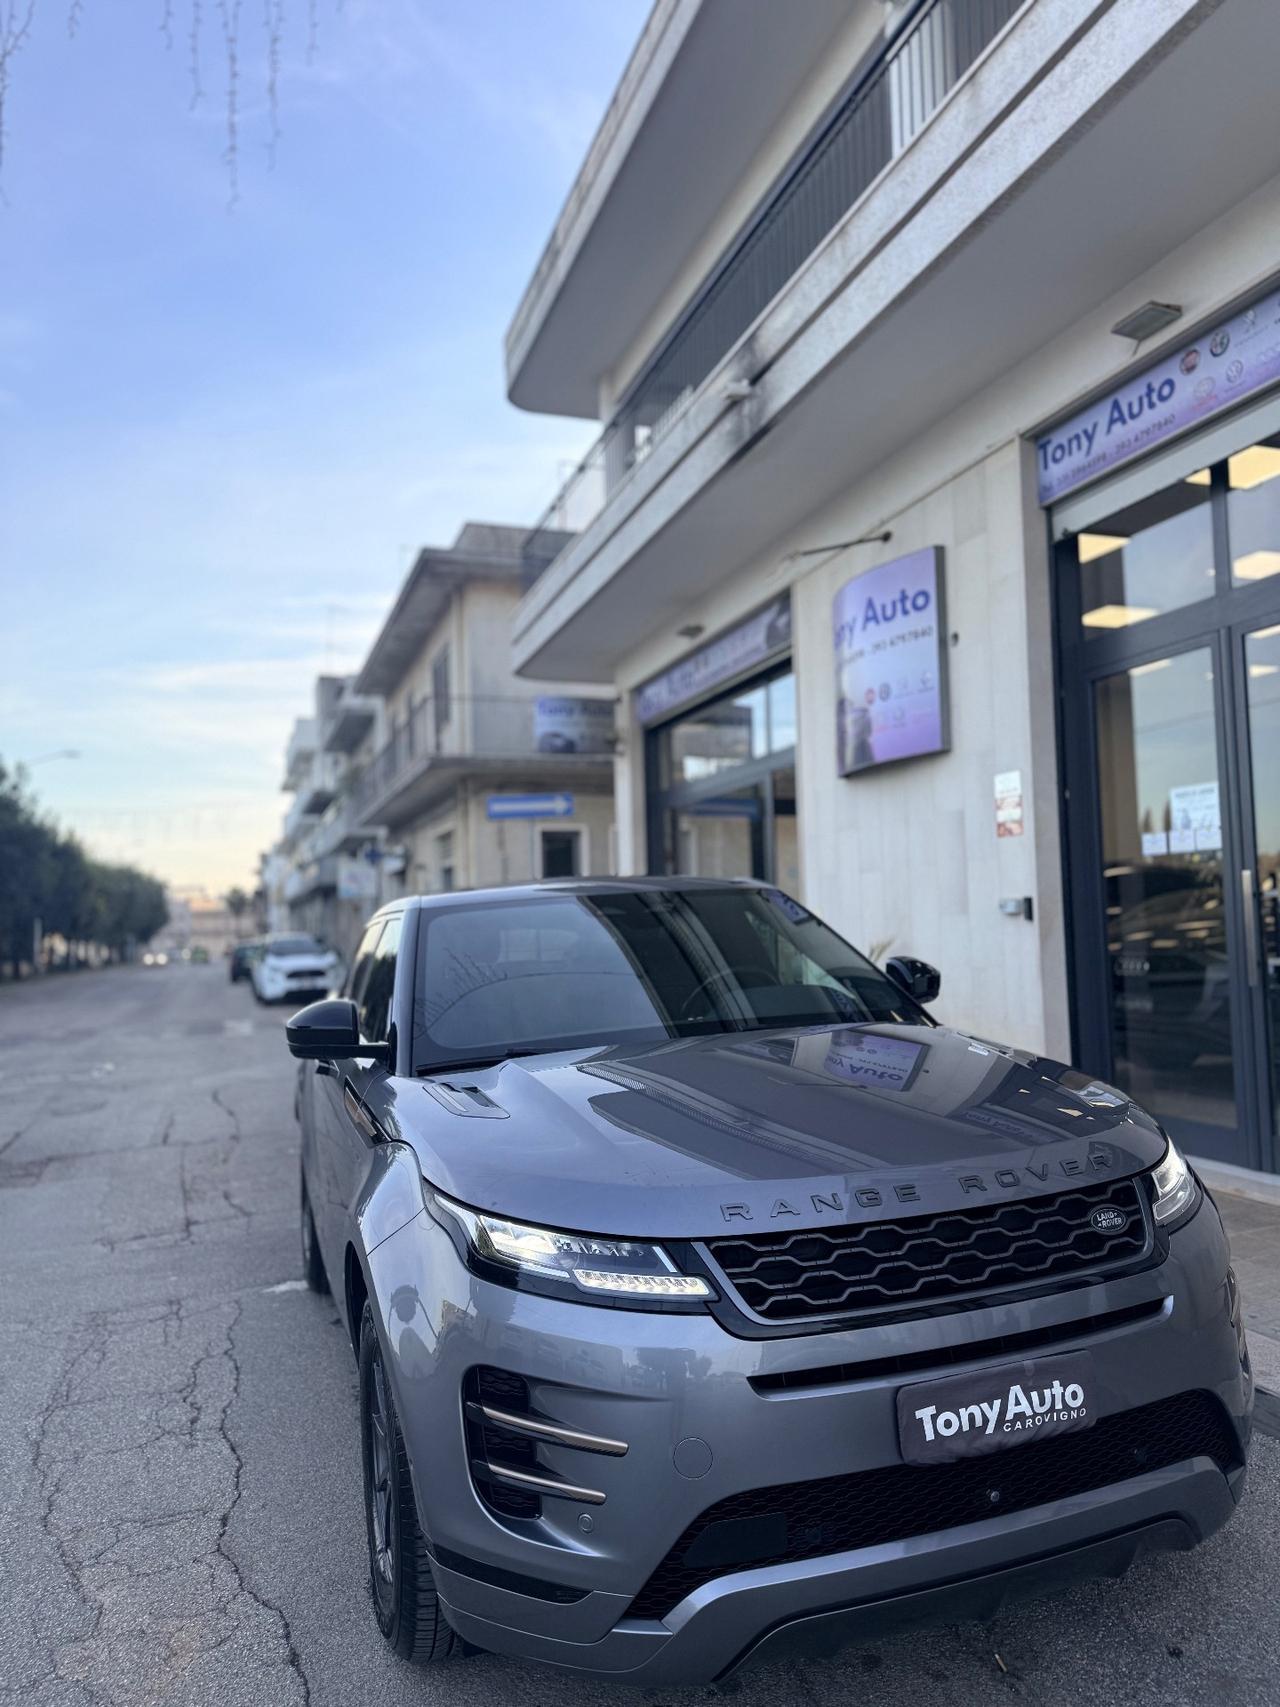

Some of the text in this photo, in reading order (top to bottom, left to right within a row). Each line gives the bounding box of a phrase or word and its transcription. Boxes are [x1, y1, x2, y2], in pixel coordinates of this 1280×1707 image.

[1038, 421, 1098, 471] Tony
[1105, 378, 1176, 435] Auto
[862, 588, 931, 631] Auto
[720, 1153, 1113, 1223] RANGE ROVER
[1096, 1211, 1115, 1222] LAND
[1101, 1217, 1122, 1228] ROVER
[914, 1380, 1085, 1442] Tony Auto
[1003, 1407, 1087, 1432] CAROVIGNO
